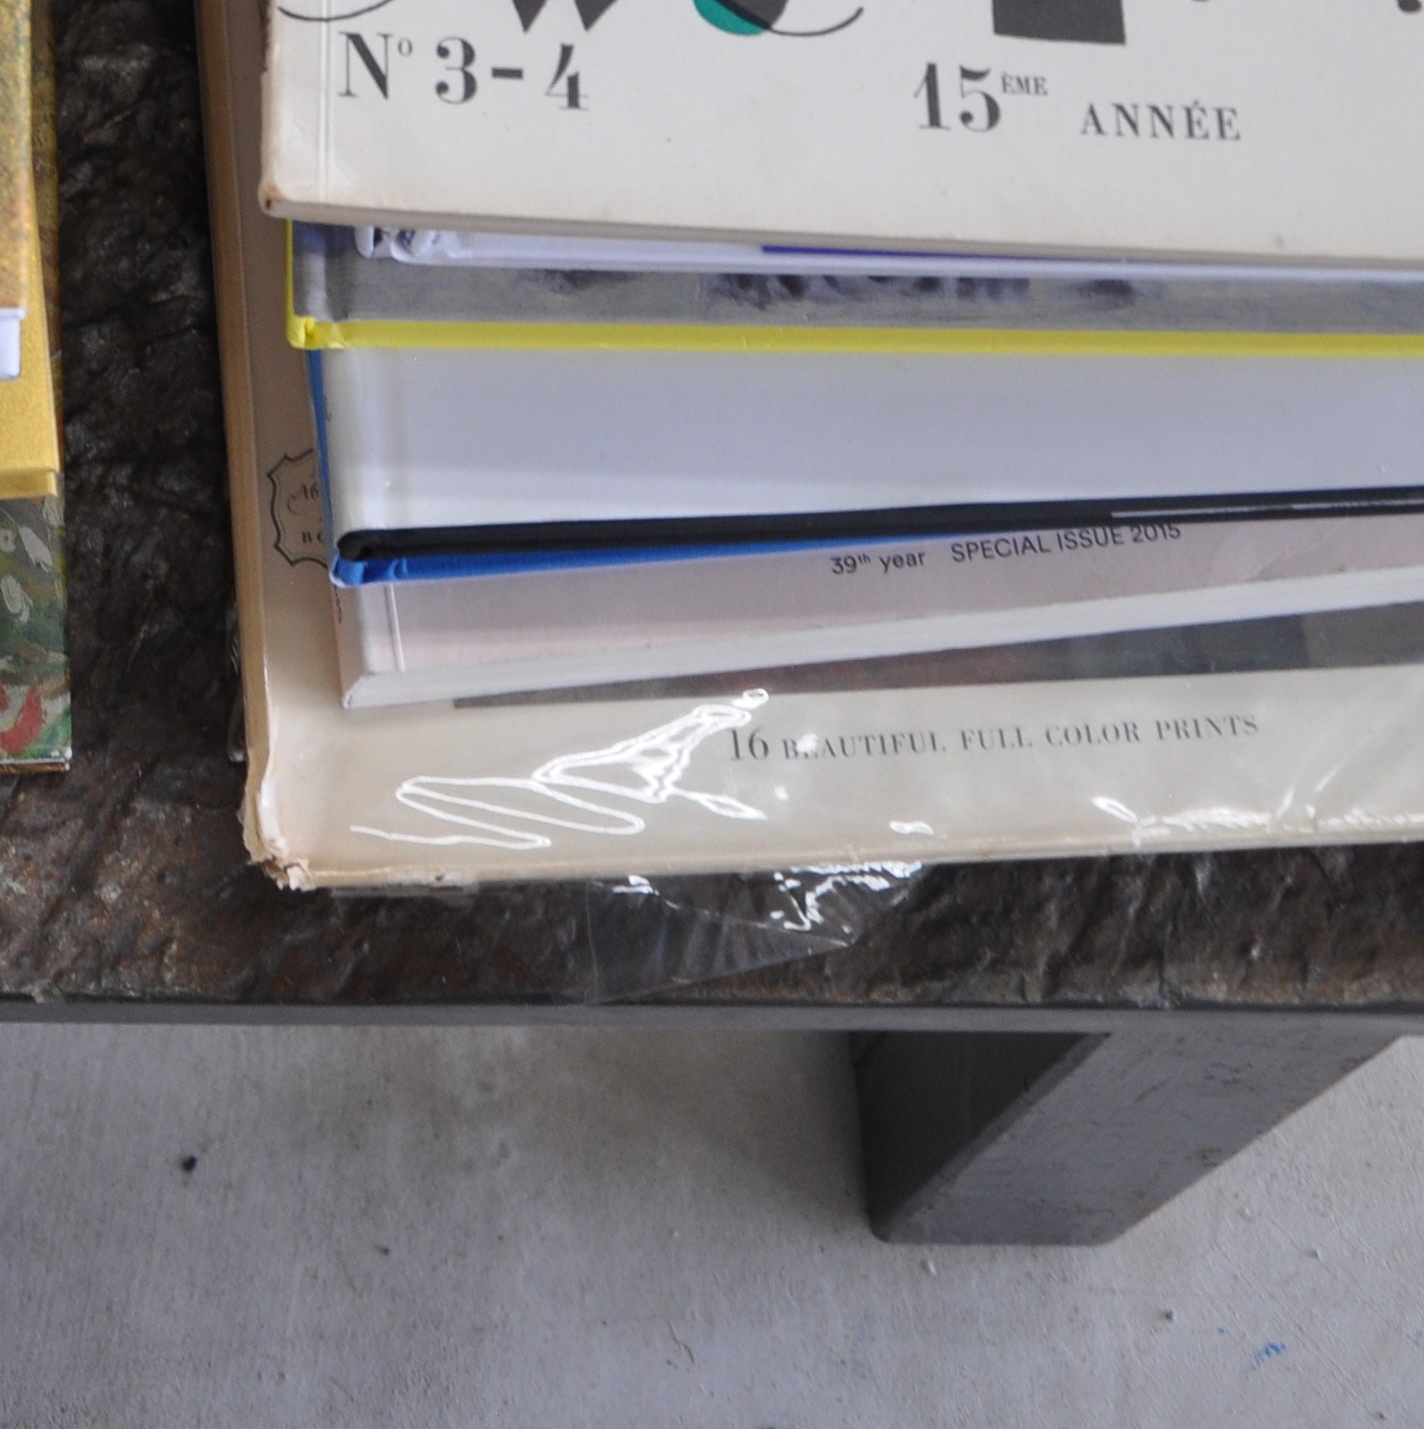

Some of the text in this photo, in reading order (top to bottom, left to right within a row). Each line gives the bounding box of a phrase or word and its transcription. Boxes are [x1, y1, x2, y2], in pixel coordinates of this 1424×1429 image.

[434, 35, 590, 112] 3-4
[1079, 100, 1242, 142] ANNÉE
[830, 523, 1182, 576] 39th year SPECIAL ISSUE 2015
[728, 727, 770, 761] 16
[961, 726, 1034, 752] FULL
[1045, 722, 1140, 749] COLOR
[1153, 715, 1260, 743] PRINTS
